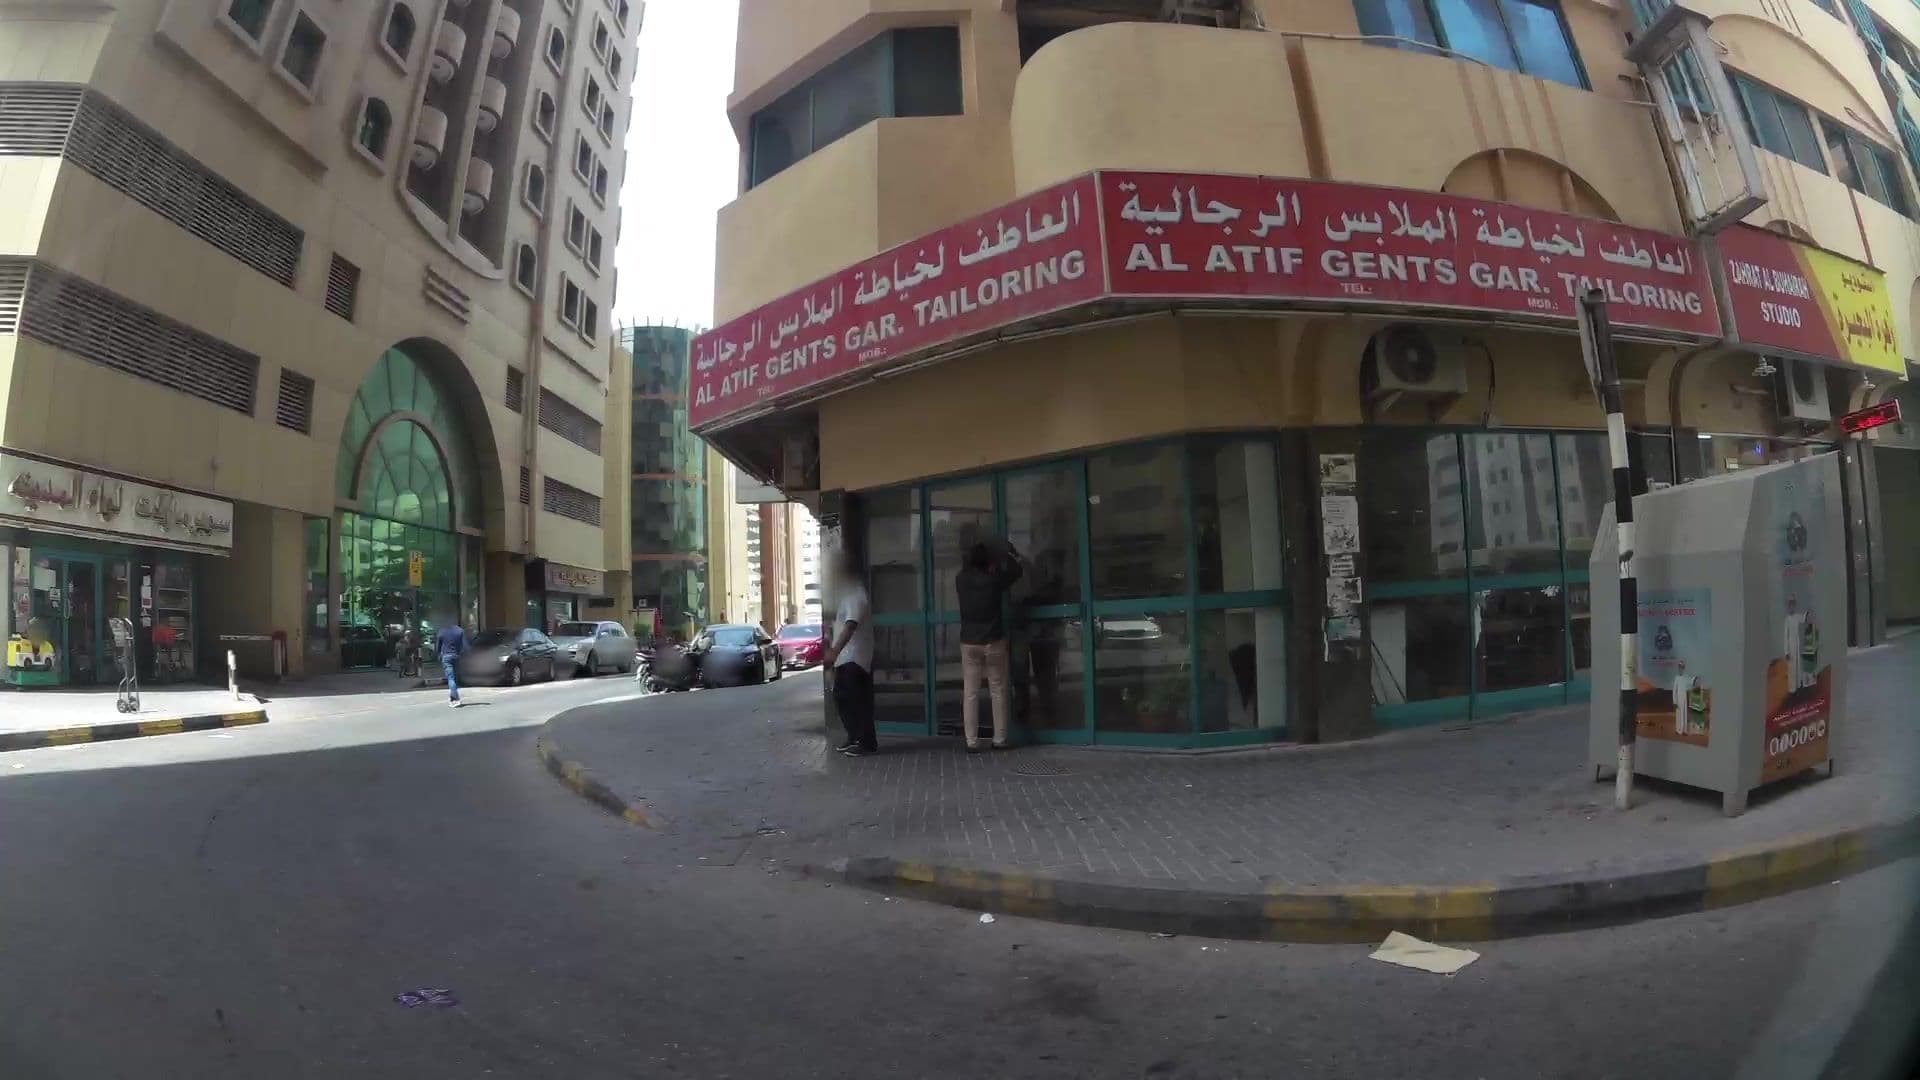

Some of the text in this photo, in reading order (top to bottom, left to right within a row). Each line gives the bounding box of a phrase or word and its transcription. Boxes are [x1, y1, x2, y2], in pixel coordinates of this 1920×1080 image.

[1118, 180, 1692, 276] العاطف لخياطة الملابس الرجالية
[696, 190, 1080, 378] العاطف لخياطة الملابس الرجالية
[1126, 243, 1189, 272] AL
[1205, 244, 1304, 274] ATIF
[1320, 249, 1458, 285] GENTS
[1469, 262, 1552, 294] GAR.
[1728, 259, 1762, 289] ZAHRAT
[1762, 267, 1775, 291] AL
[696, 250, 1085, 408] AL ATIF GENTS GAR. TAILORING
[1760, 301, 1801, 328] STUDIO
